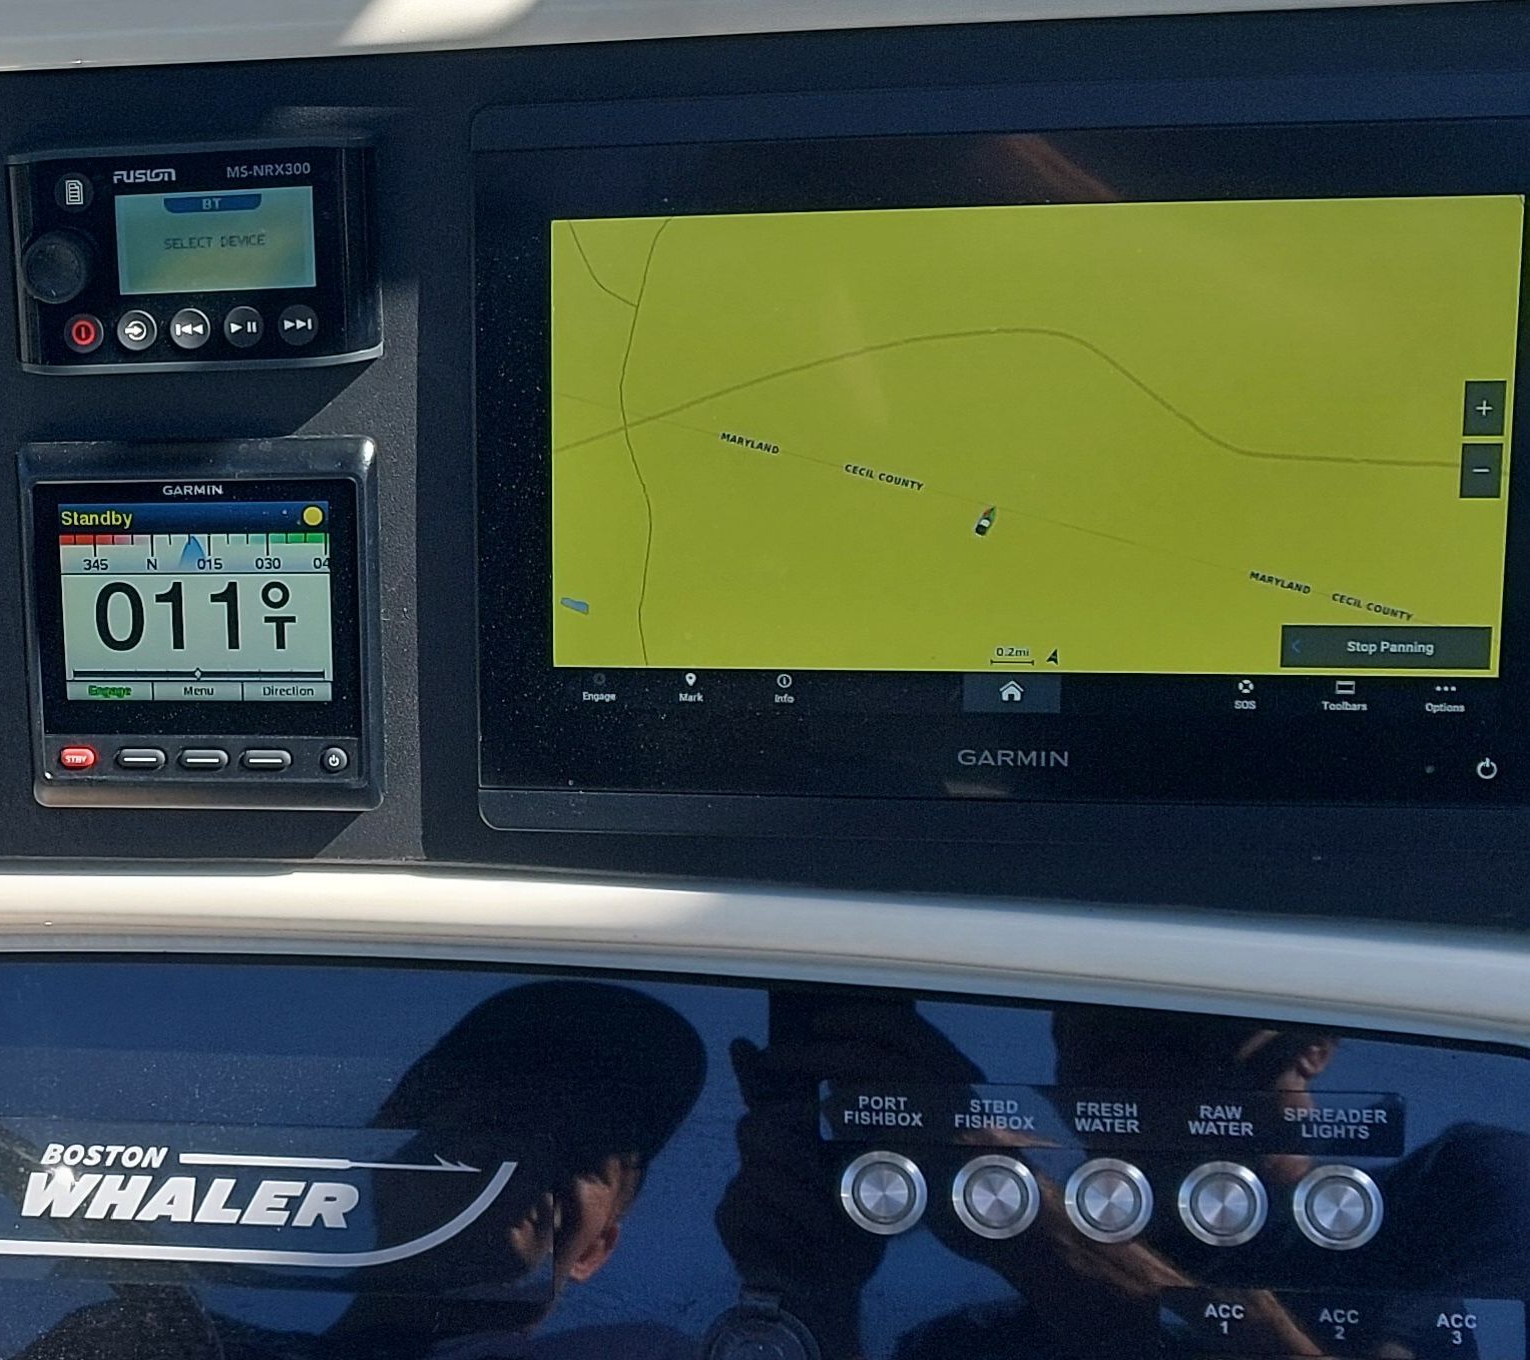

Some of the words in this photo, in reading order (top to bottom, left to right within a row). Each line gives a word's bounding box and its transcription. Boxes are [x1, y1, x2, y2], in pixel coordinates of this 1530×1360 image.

[113, 168, 176, 184] FUSION
[226, 163, 311, 179] MS-NRX300
[202, 199, 221, 210] BT
[164, 236, 213, 249] SELECT
[221, 234, 266, 247] DEVICE
[719, 431, 780, 455] MARYLAND
[844, 463, 874, 480] CECIL
[878, 471, 924, 491] COUNTY
[163, 484, 224, 496] GARMIN
[61, 511, 133, 529] Standby
[83, 559, 108, 571] 345
[147, 559, 157, 571] N
[197, 558, 223, 570] 015
[255, 558, 281, 570] 030
[1249, 570, 1311, 595] MARYLAND
[1331, 592, 1362, 610] CECIL
[1366, 601, 1414, 622] COUNTY
[1346, 641, 1377, 655] Stop
[1380, 641, 1434, 656] Panning
[88, 685, 131, 697] Engage
[183, 685, 214, 696] Menu
[262, 685, 314, 697] Direction
[582, 691, 616, 703] Engage
[679, 692, 703, 703] Mark
[774, 693, 795, 704] Info
[1234, 700, 1256, 709] SOS
[1322, 700, 1367, 712] Toolbars
[1425, 702, 1465, 714] Options
[64, 754, 87, 764] STBY
[957, 749, 1069, 767] GARMIN
[858, 1096, 908, 1112] PORT
[969, 1098, 1019, 1115] STBD
[1075, 1101, 1139, 1118] FRESH
[1198, 1104, 1243, 1121] RAW
[843, 1110, 924, 1128] FISHBOX
[954, 1113, 1035, 1131] FISHBOX
[1283, 1106, 1387, 1124] SPREADER
[1074, 1116, 1141, 1134] WATER
[1188, 1119, 1254, 1137] WATER
[1301, 1122, 1371, 1140] LIGHTS
[41, 1143, 168, 1169] BOSTON
[21, 1171, 359, 1229] WHALER
[1204, 1303, 1245, 1321] ACC
[1319, 1307, 1360, 1325] ACC
[1221, 1320, 1229, 1335] 1
[1436, 1312, 1478, 1330] ACC
[1335, 1324, 1347, 1340] 2
[1451, 1329, 1463, 1346] 3
